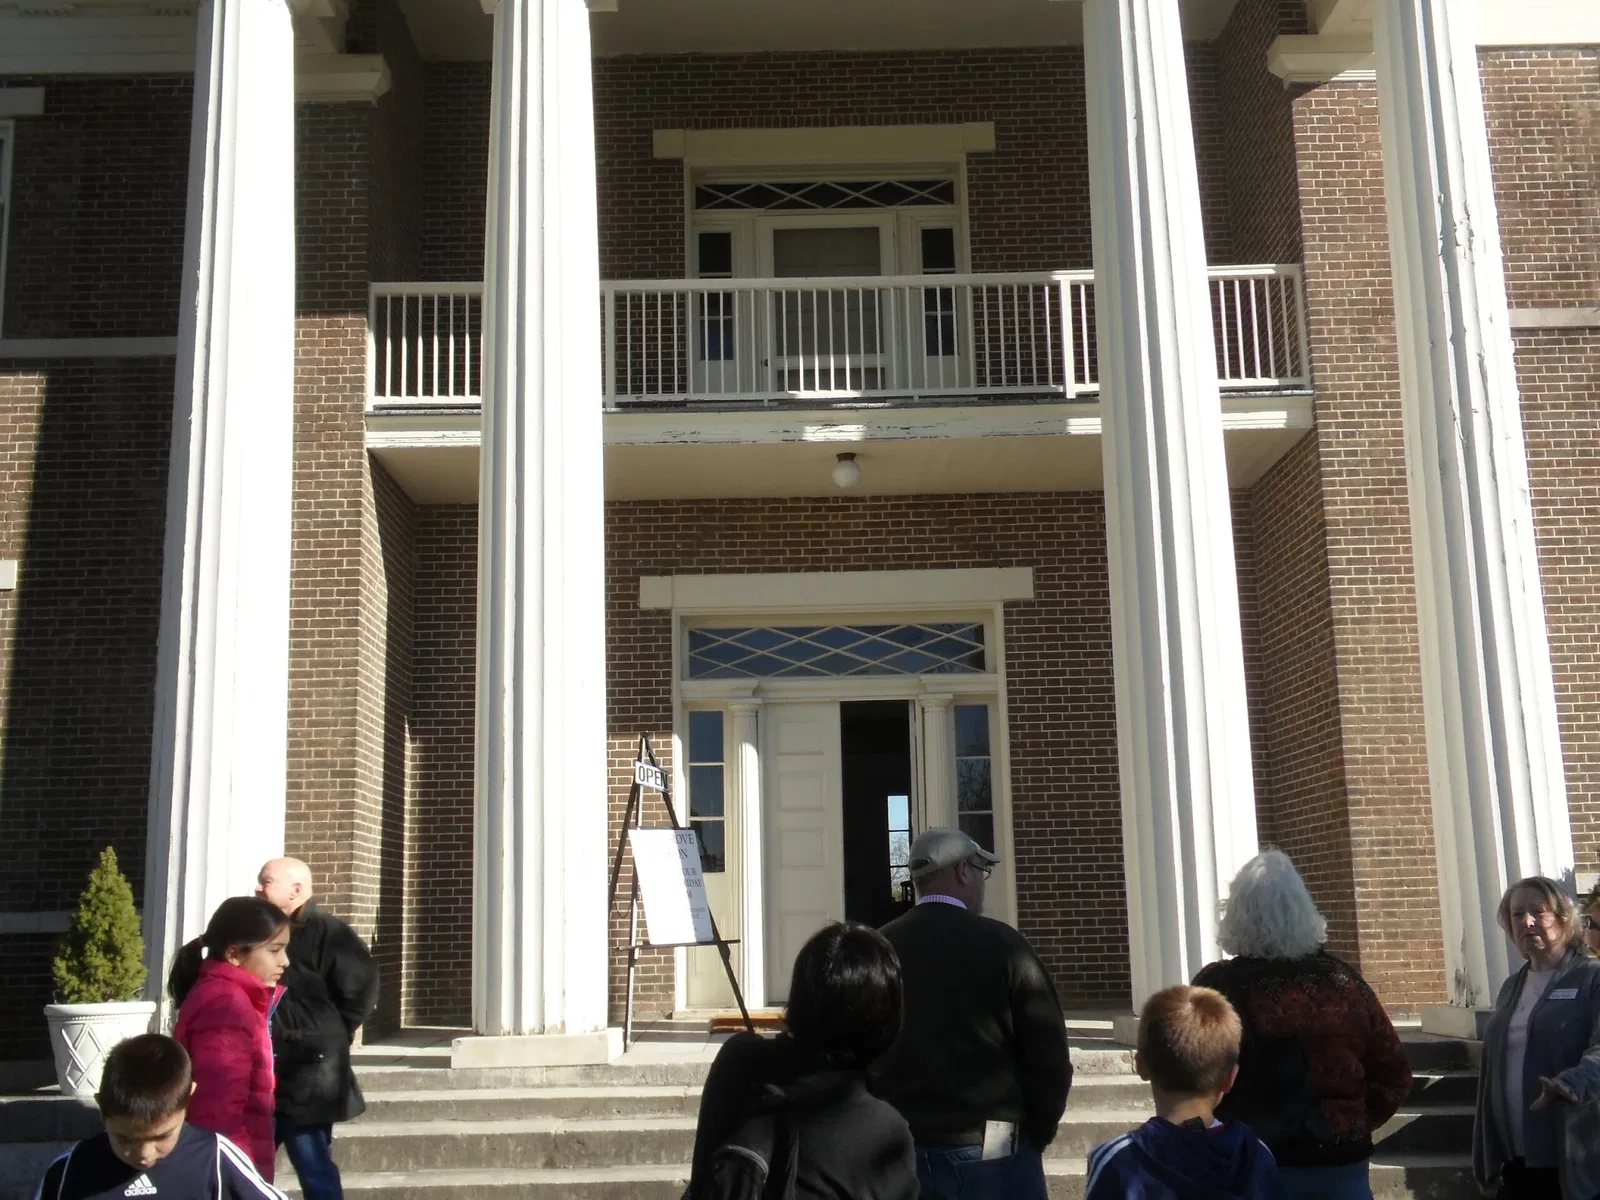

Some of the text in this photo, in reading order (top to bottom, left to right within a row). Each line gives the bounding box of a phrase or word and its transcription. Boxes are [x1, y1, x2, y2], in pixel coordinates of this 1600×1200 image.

[638, 765, 668, 789] OPEN
[684, 878, 702, 888] IDAY
[124, 1186, 157, 1197] adidas
